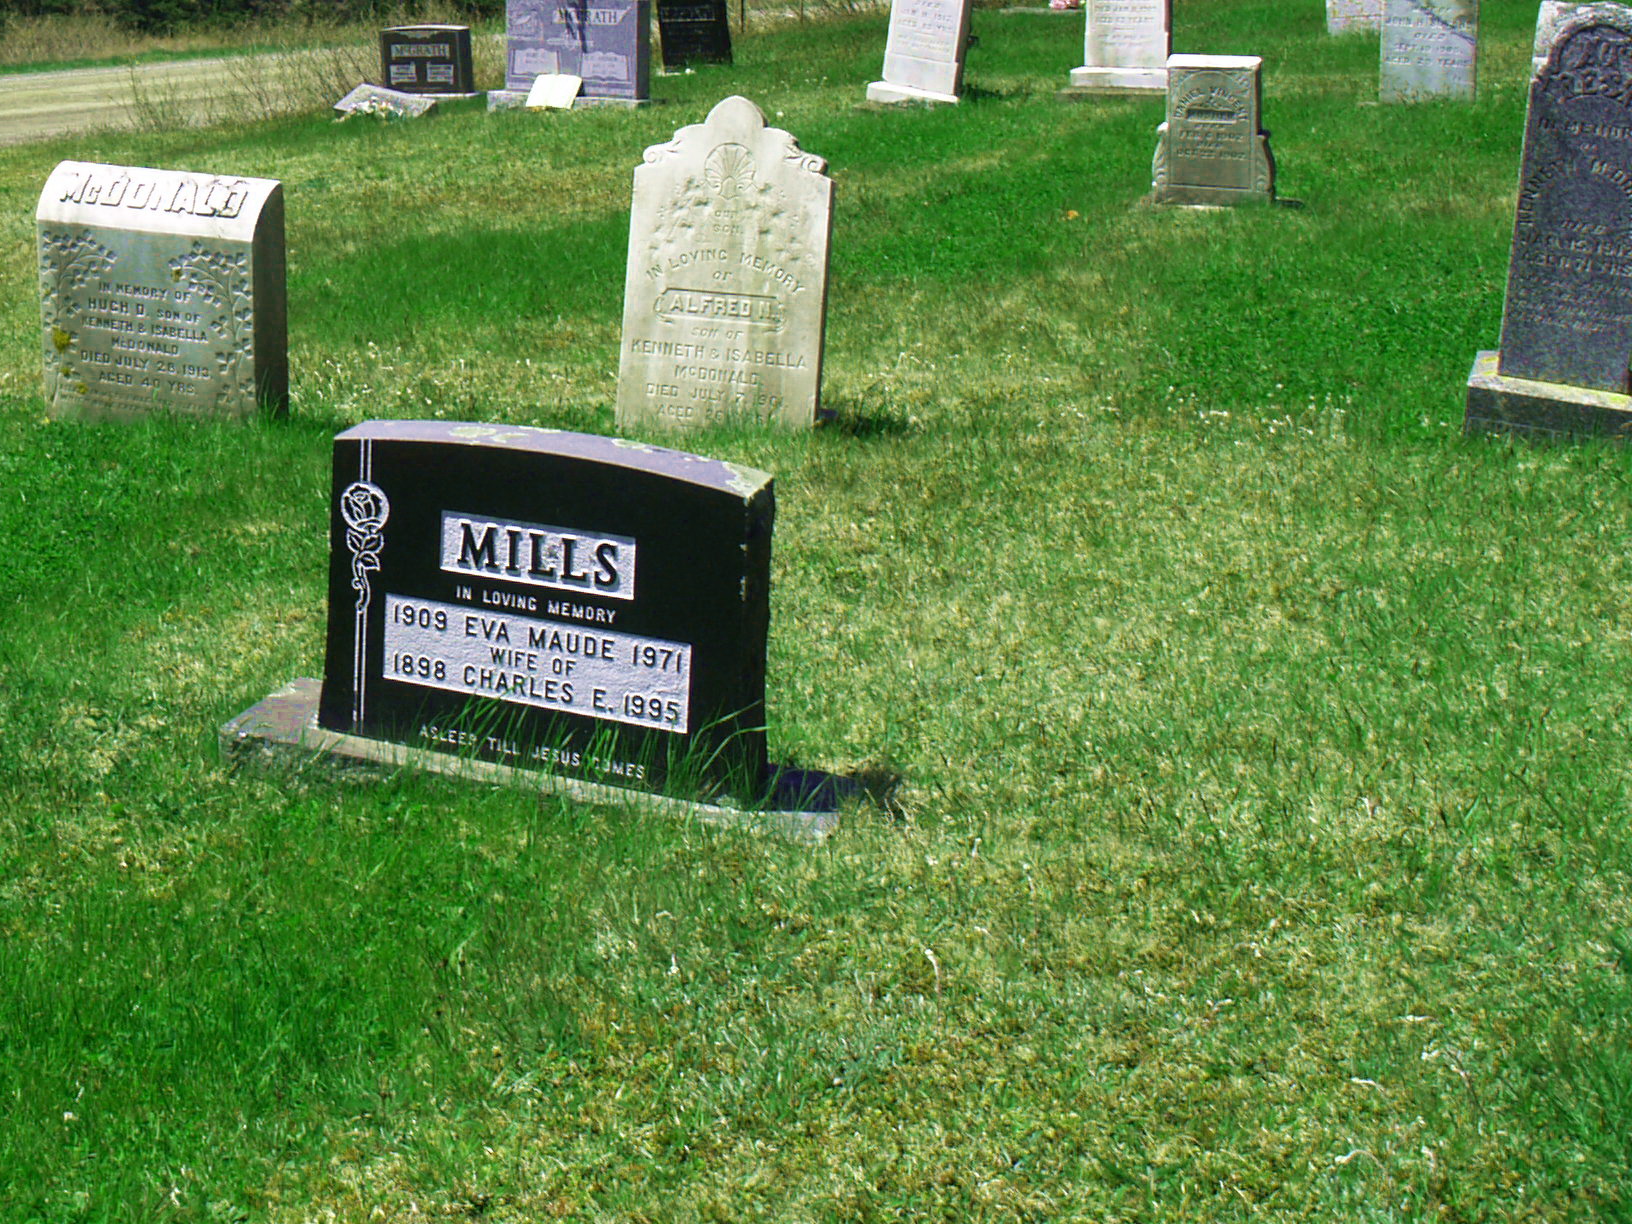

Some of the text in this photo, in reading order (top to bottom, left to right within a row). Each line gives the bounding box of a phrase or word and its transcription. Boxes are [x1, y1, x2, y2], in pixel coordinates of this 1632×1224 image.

[59, 172, 249, 218] McDONALD
[645, 249, 807, 296] IN LOVING MEMORY
[712, 270, 733, 281] OF
[99, 282, 191, 303] IN MEMORY OF
[88, 297, 130, 316] HUGH
[157, 309, 181, 323] SON
[185, 312, 201, 324] OF
[668, 294, 753, 319] ALFRED
[81, 316, 135, 334] KENNETH
[151, 325, 209, 343] ISABELLA
[691, 327, 745, 341] SON OF
[80, 349, 111, 366] DIED
[115, 355, 150, 373] JULY
[631, 338, 706, 359] KENNETH
[726, 347, 808, 369] ISABELLA
[99, 370, 133, 387] AGED
[646, 382, 680, 398] DIED
[691, 386, 726, 402] JULY
[656, 403, 695, 419] AGED
[457, 522, 619, 590] MILLS
[456, 585, 617, 624] IN LOVING MEMORY
[393, 602, 683, 675] 1909 EVA MAUDE 1971
[489, 646, 578, 676] WIFE OF
[392, 652, 682, 725] 1898 CHARLES E. 1995
[418, 724, 478, 747] ASLEEP
[485, 736, 521, 756] TILL
[531, 745, 582, 768] JESUS
